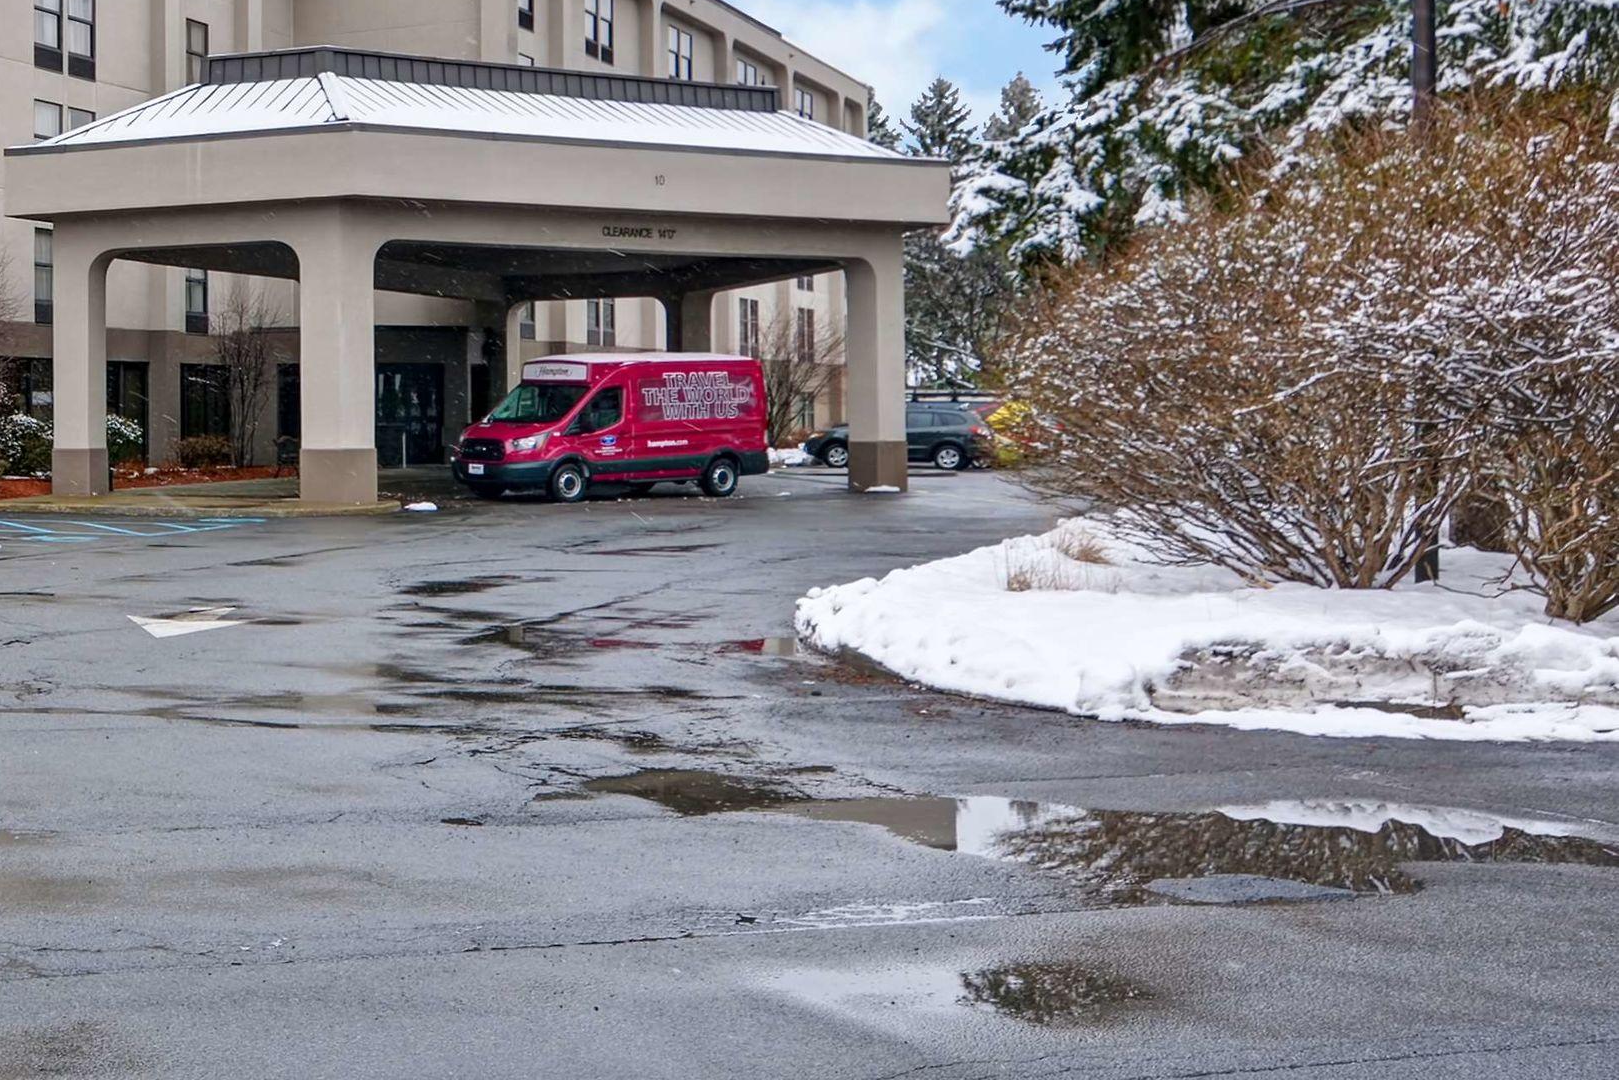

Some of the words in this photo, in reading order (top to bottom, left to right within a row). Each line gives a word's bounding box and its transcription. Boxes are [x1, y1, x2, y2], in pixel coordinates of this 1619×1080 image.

[602, 226, 654, 238] CLEARANCE
[662, 371, 734, 389] TRAVEL
[642, 387, 682, 406] THE
[683, 384, 751, 405] WORLD
[662, 402, 710, 420] WITH
[714, 401, 739, 419] US
